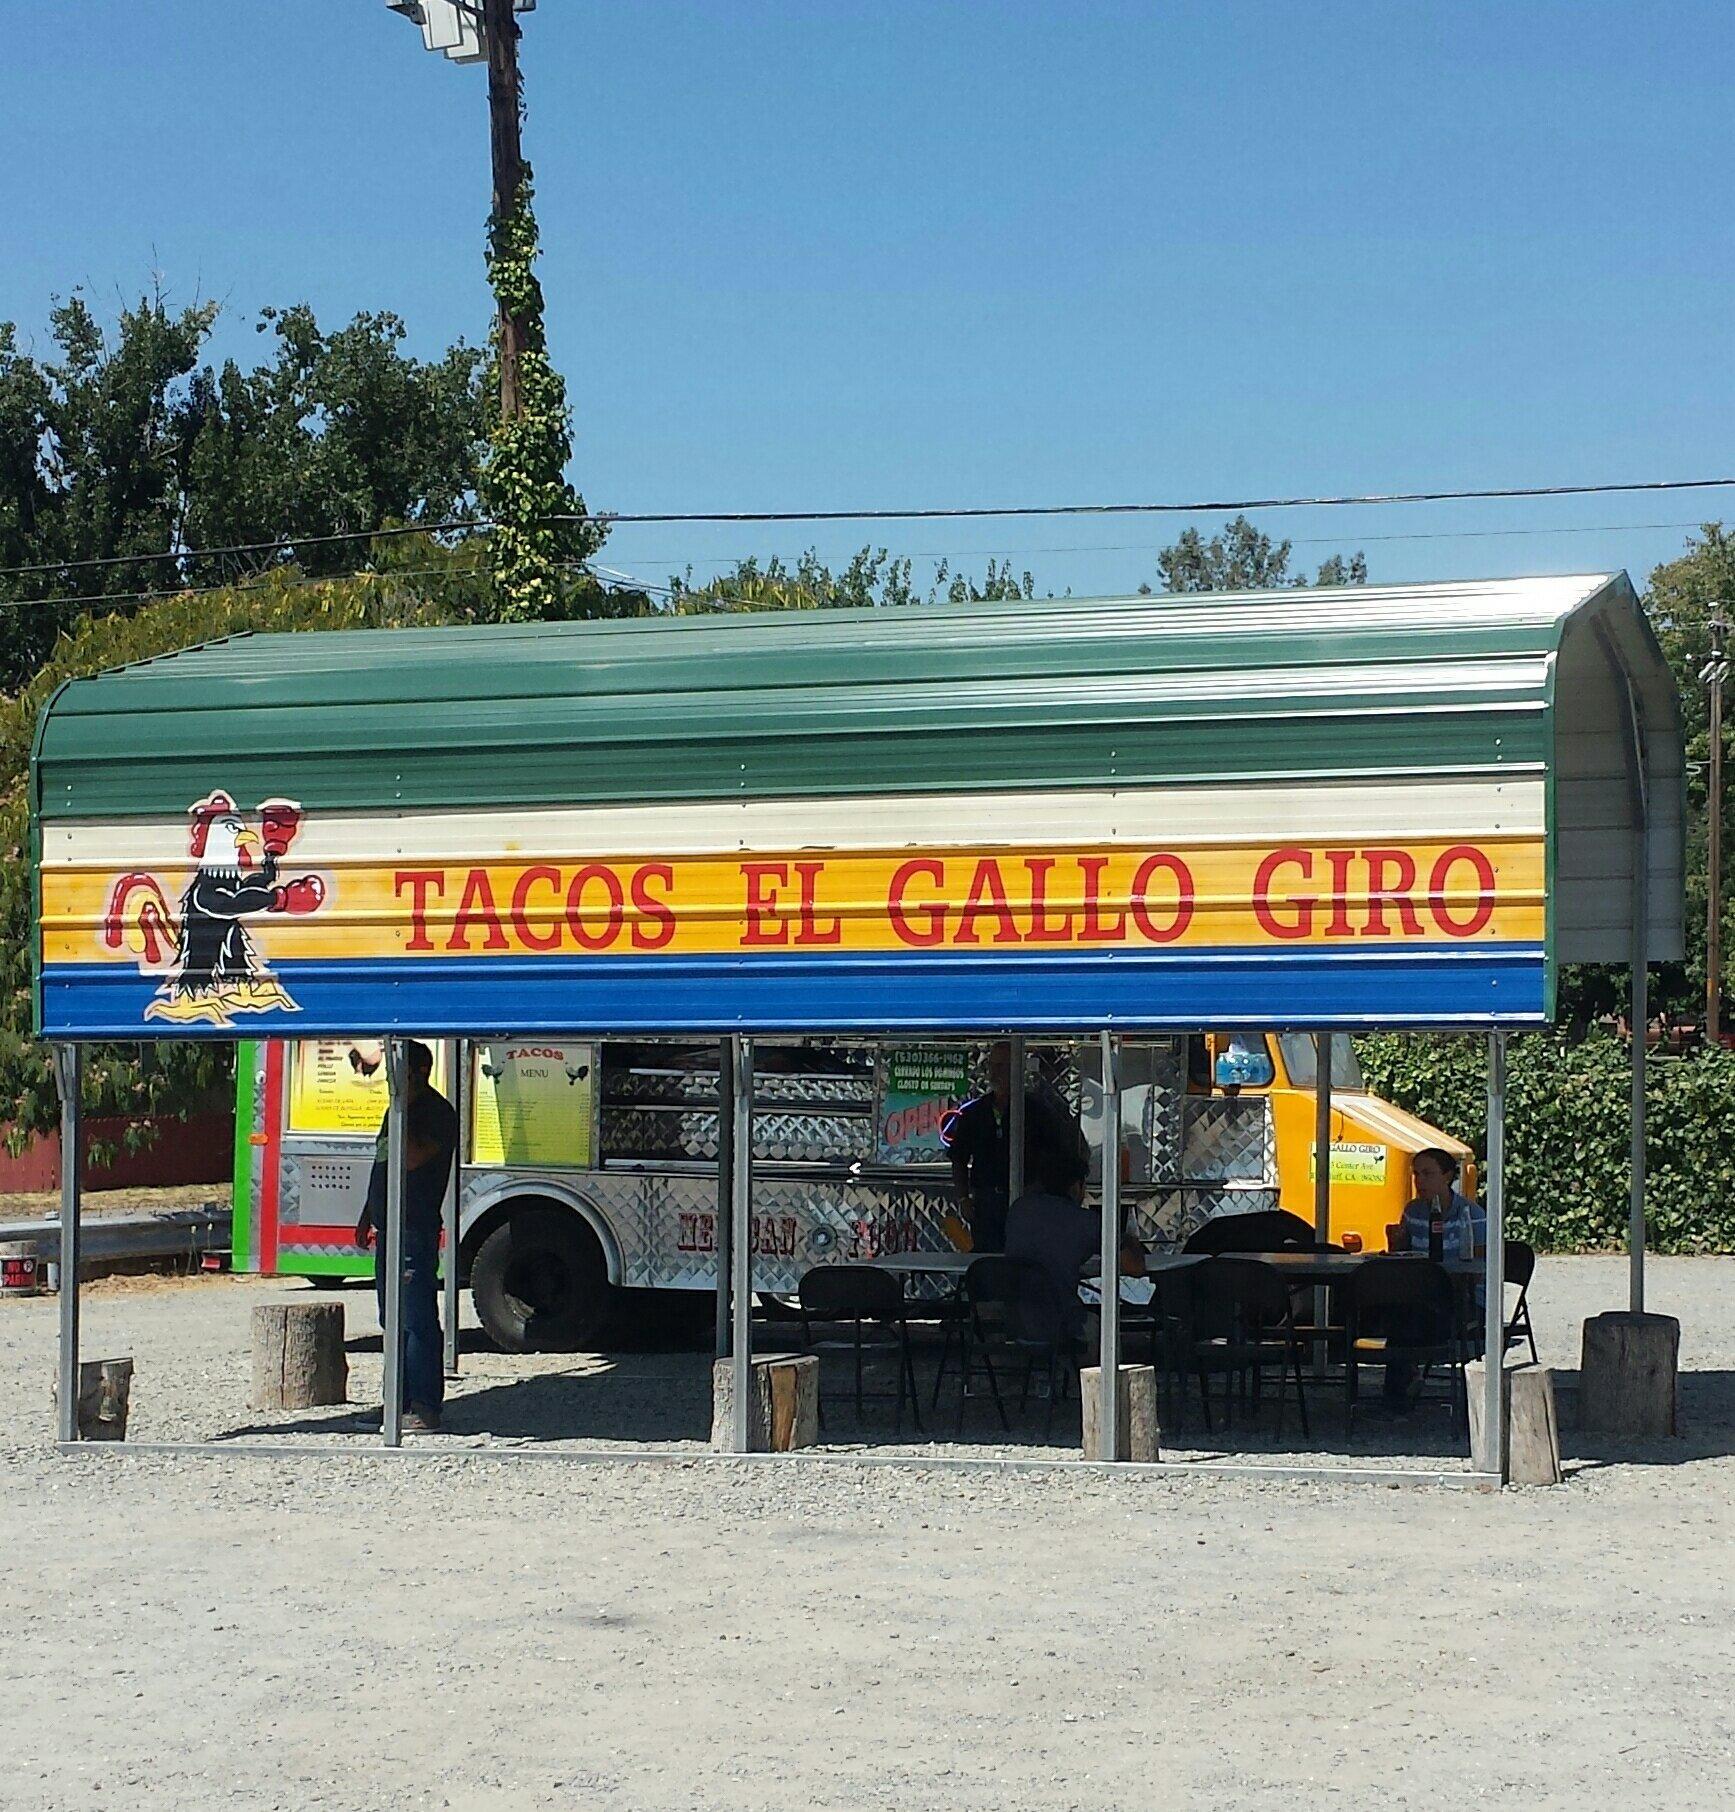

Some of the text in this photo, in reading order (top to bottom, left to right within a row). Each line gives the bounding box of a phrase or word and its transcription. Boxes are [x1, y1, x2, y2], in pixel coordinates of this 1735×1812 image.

[394, 845, 1498, 951] TACOS EL GALLO GIRO
[505, 1047, 565, 1061] TACOS
[520, 1069, 550, 1078] MENU
[885, 1097, 949, 1145] OPEN
[1358, 1145, 1381, 1154] GIRO
